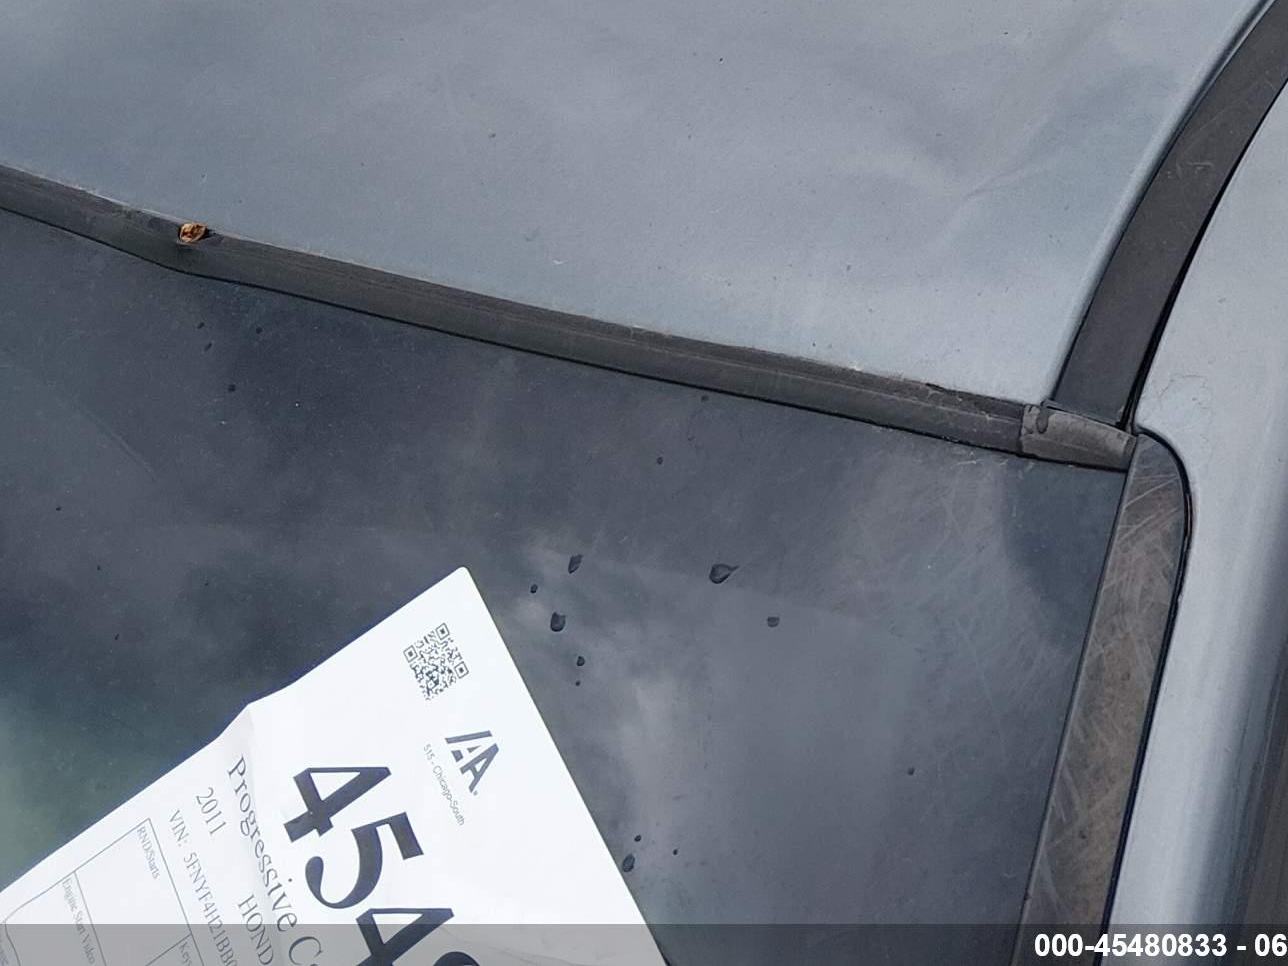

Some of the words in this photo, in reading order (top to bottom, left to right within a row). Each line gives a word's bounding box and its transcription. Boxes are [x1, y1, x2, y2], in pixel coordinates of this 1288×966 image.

[445, 730, 499, 793] IAA
[169, 810, 190, 847] VIN:
[196, 786, 226, 834] 2011
[227, 754, 298, 932] Progressive
[289, 936, 324, 966] C
[284, 767, 480, 966] 454
